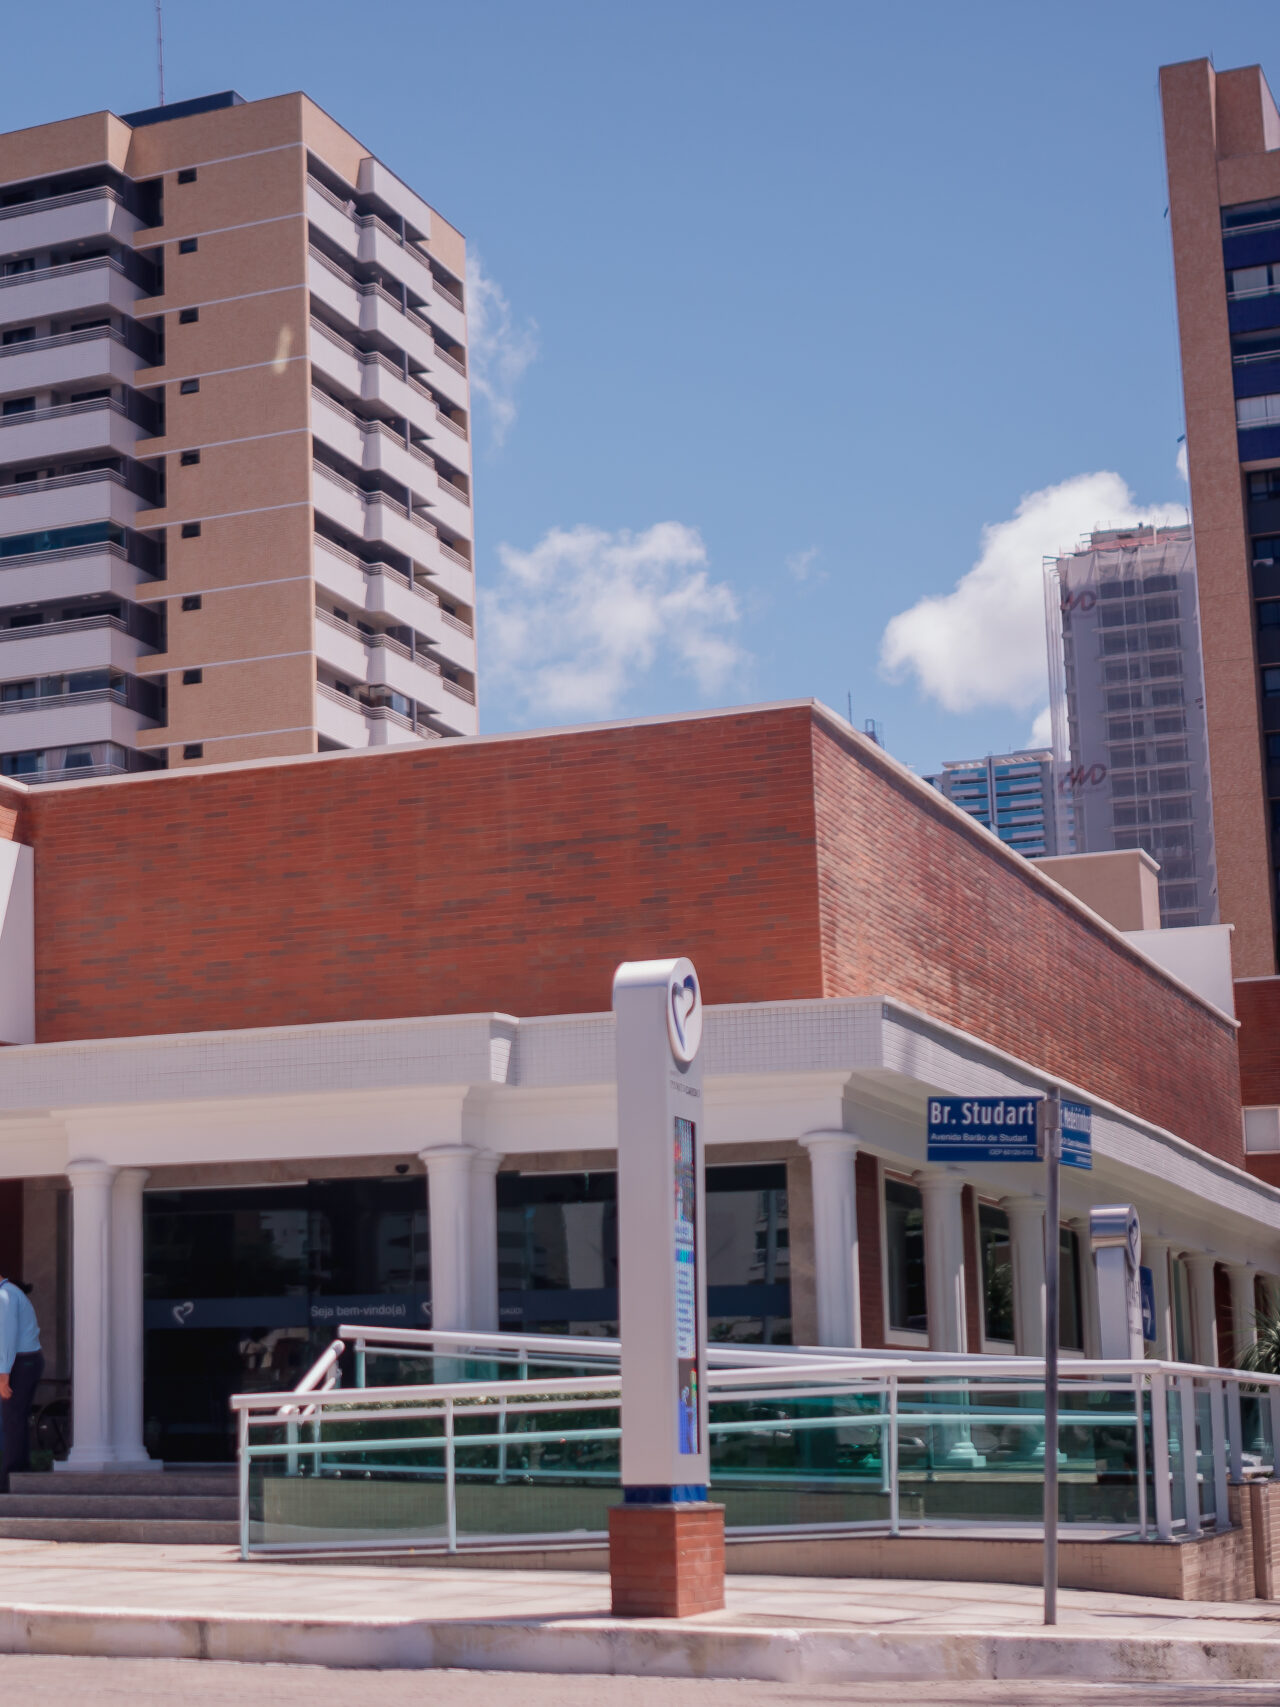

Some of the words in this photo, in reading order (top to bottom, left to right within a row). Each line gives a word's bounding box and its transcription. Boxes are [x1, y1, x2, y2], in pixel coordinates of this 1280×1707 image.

[930, 1102, 957, 1125] Br.
[961, 1101, 1035, 1126] Studart
[930, 1133, 962, 1141] Avenida
[963, 1133, 986, 1142] Barão
[988, 1134, 998, 1142] de
[999, 1134, 1028, 1142] Studart
[310, 1304, 334, 1319] Seja
[336, 1303, 407, 1318] bem-vindo(a)
